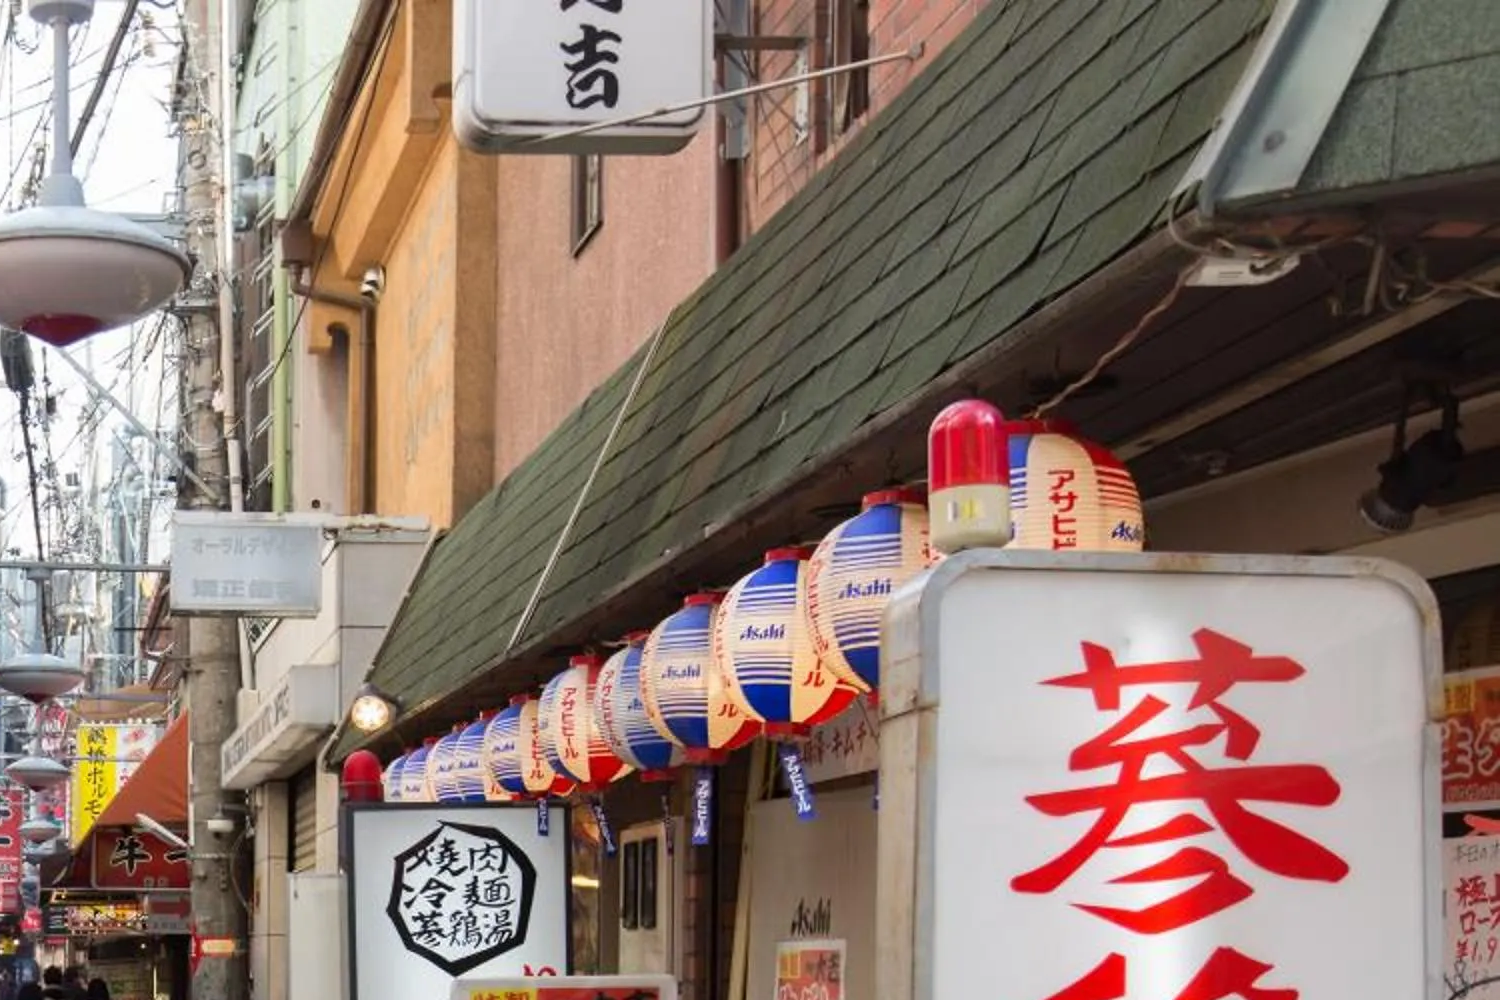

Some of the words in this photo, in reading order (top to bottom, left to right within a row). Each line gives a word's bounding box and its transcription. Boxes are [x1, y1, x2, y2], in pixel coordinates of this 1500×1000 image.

[560, 0, 622, 109] 吉
[839, 578, 892, 599] Asahi
[739, 623, 786, 641] Asahi
[661, 663, 702, 679] Asahi
[561, 686, 580, 760] アサヒビール
[84, 726, 107, 822] 鶴橋ホルモ
[789, 895, 833, 937] Asahi
